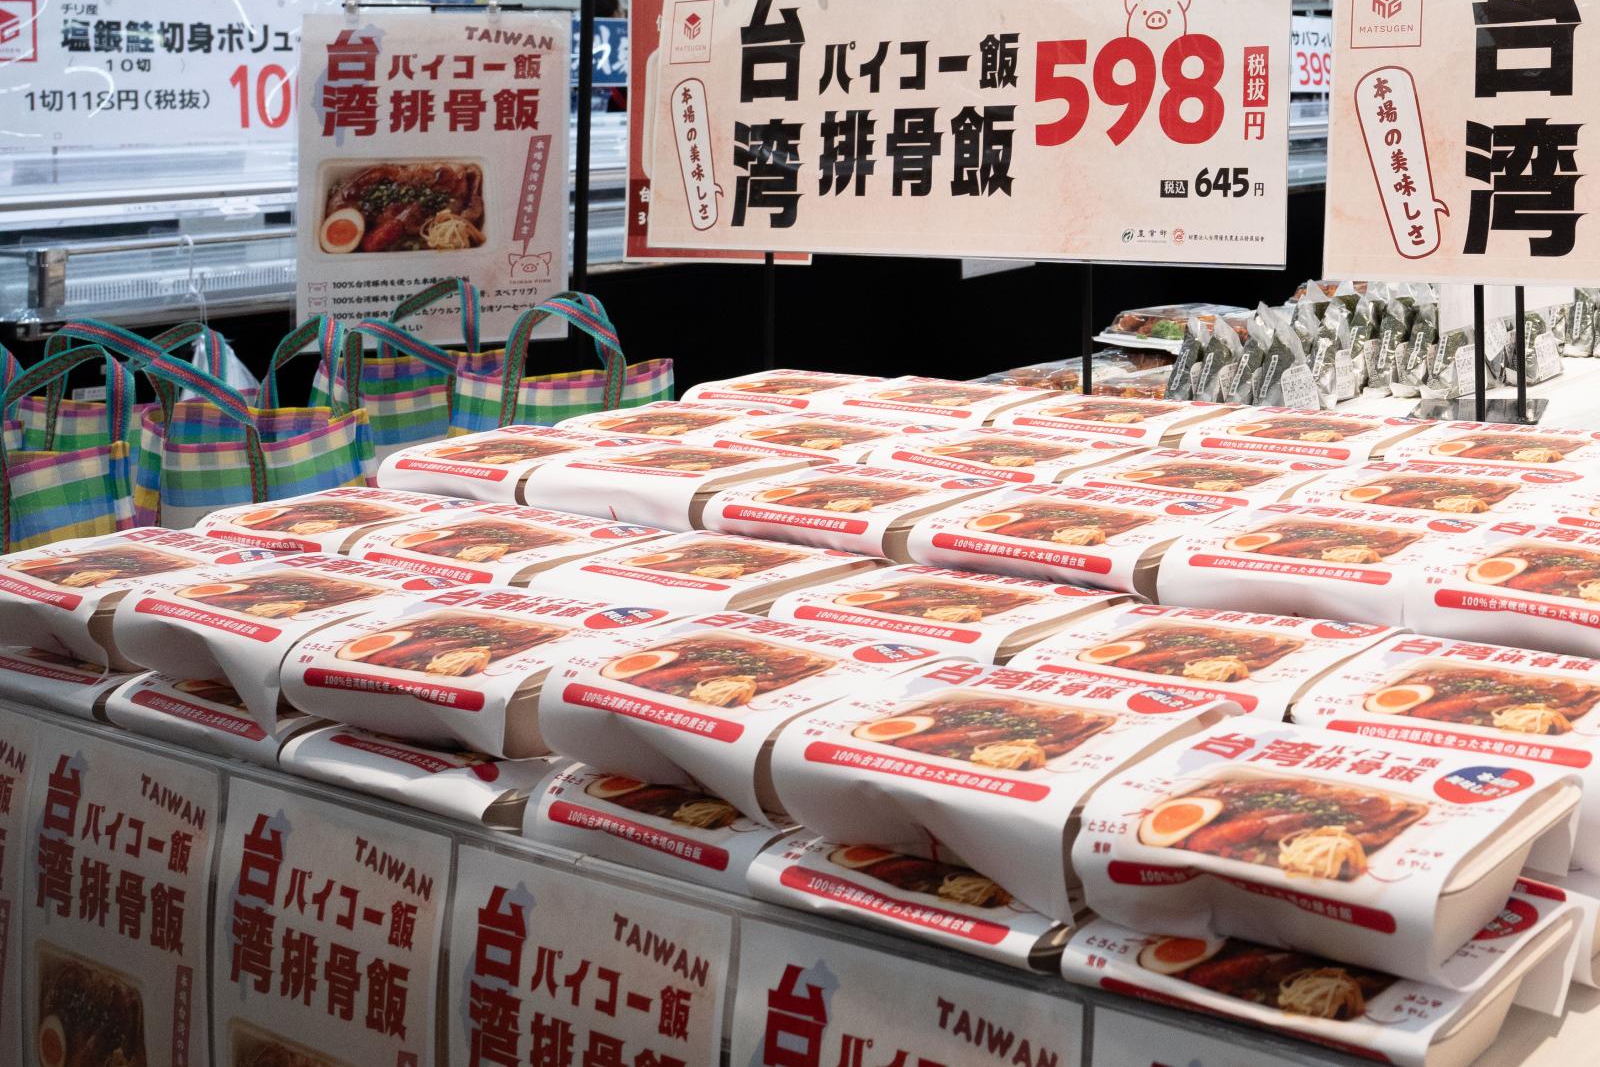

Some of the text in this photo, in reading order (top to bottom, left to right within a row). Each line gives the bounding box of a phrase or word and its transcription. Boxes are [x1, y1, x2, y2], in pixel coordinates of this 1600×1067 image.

[60, 19, 300, 55] 塩銀鮭切身ボリュ
[61, 3, 98, 16] チリ産
[465, 26, 554, 51] TAIWAN
[1358, 23, 1414, 34] MATSUGEN
[229, 63, 300, 129] 10
[387, 53, 543, 81] パイコー飯
[818, 32, 1021, 96] パイコー飯
[1033, 33, 1225, 148] 598
[389, 87, 540, 134] 排骨飯
[681, 87, 710, 221] 本場の美味しさ
[818, 104, 1020, 198] 排骨飯
[1194, 167, 1251, 199] 645
[1373, 77, 1426, 246] 本場の美味しさ
[1192, 732, 1326, 769] 台湾
[1308, 755, 1429, 785] 排骨飯
[1355, 723, 1556, 762] 100%台湾豚肉を使った本場の屋台飯
[139, 772, 208, 831] TAIWAN
[80, 801, 195, 877] パイコー飯
[354, 835, 436, 903] TAIWAN
[78, 855, 189, 959] 排骨飯
[283, 866, 420, 953] パイコー飯
[611, 911, 712, 990] TAIWAN
[280, 926, 412, 1043] 排骨飯
[530, 945, 696, 1044] パイコー飯
